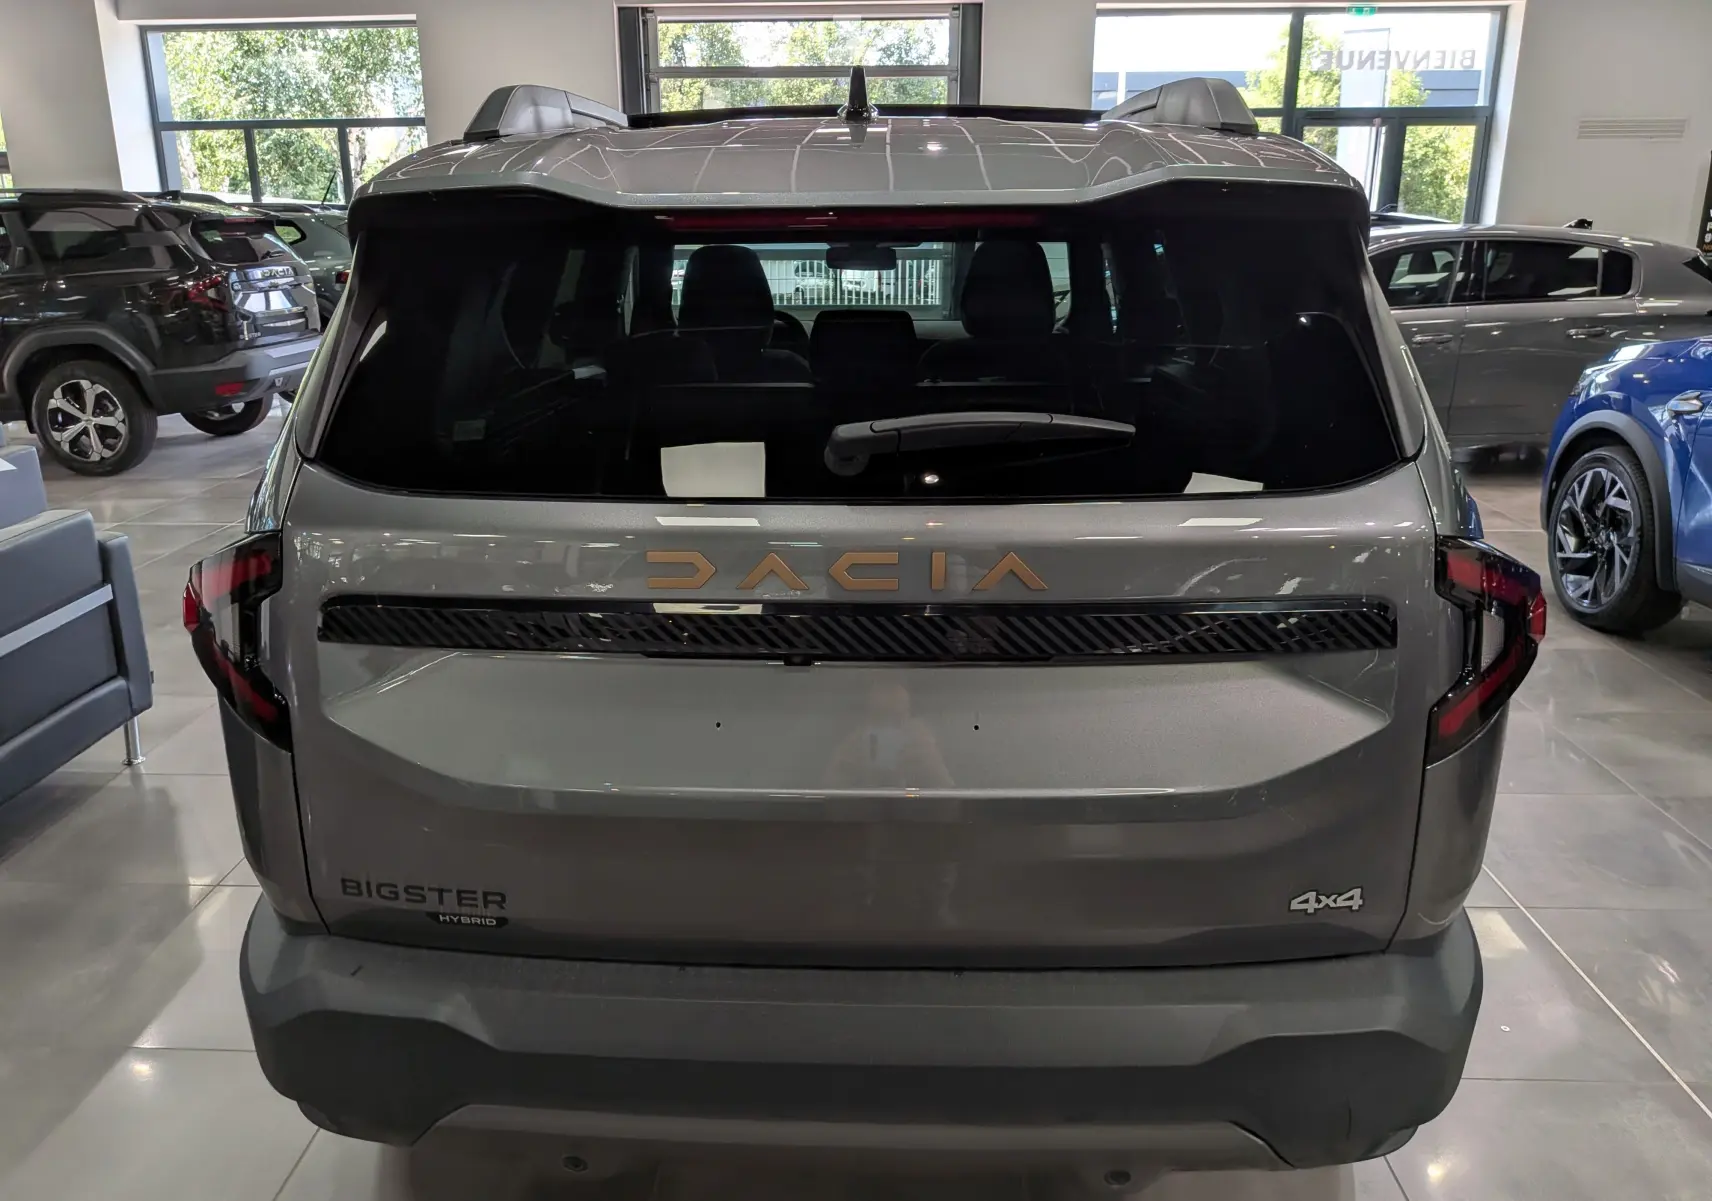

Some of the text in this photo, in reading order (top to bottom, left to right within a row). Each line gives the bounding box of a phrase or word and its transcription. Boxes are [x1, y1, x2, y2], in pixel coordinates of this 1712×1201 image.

[263, 267, 295, 278] DACIA
[646, 551, 1049, 591] DACIA
[340, 877, 507, 910] BIGSTER
[1289, 887, 1364, 914] 4x4
[438, 914, 497, 926] HYBRID
